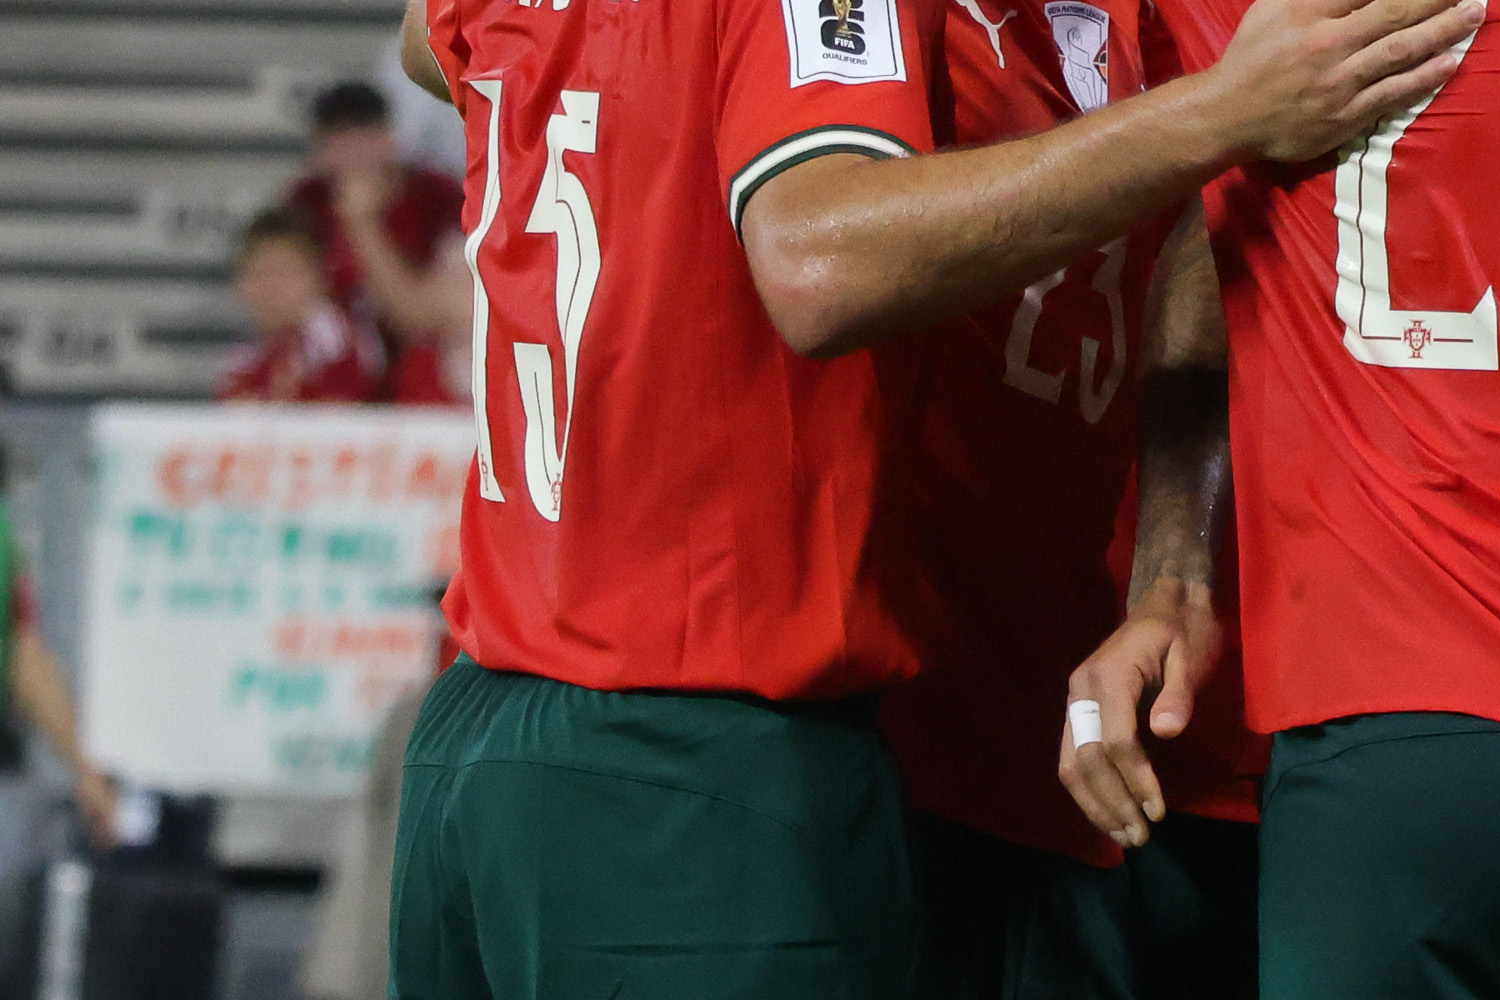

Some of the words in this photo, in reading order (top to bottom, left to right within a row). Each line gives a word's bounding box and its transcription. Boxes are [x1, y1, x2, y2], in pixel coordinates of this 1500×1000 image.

[834, 36, 856, 50] FIFA
[822, 52, 868, 66] QUALIFIERS
[465, 79, 601, 521] 15
